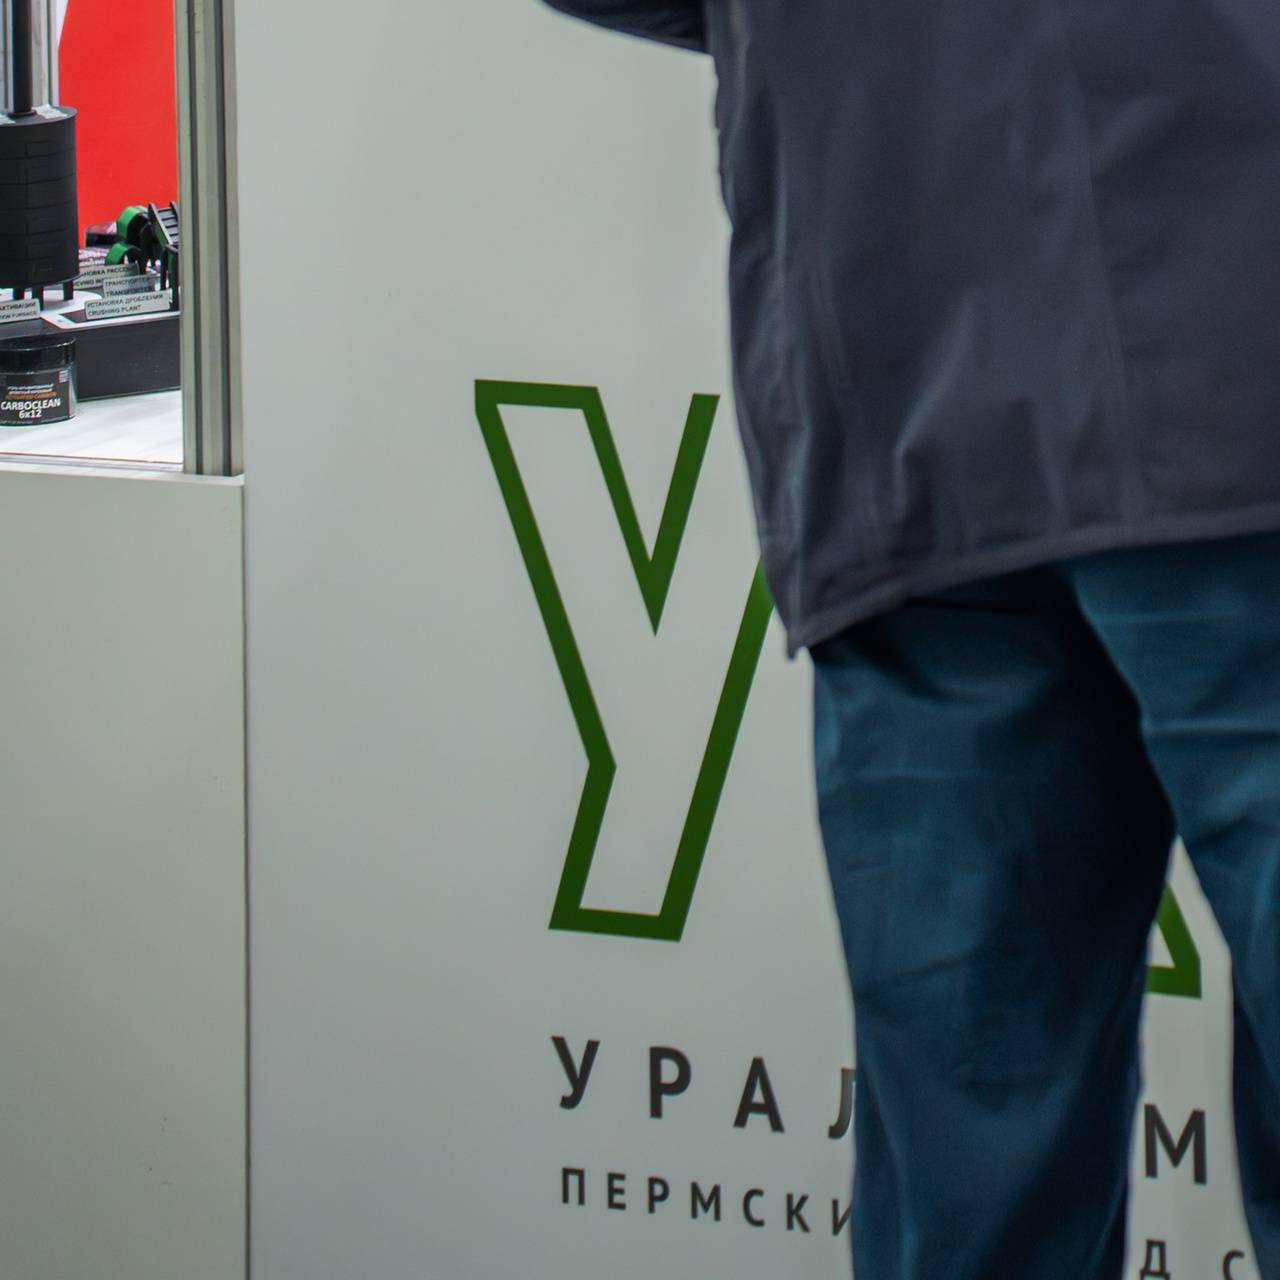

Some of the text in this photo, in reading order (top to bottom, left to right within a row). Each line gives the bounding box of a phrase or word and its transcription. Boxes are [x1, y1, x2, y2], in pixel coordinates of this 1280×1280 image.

[87, 299, 123, 309] УСТАНОВКА
[87, 304, 142, 317] CRUSHING PLANT
[0, 397, 61, 411] CARBOCLEAN
[19, 409, 42, 419] 6x12
[560, 1167, 852, 1237] ПЕРМСКИ
